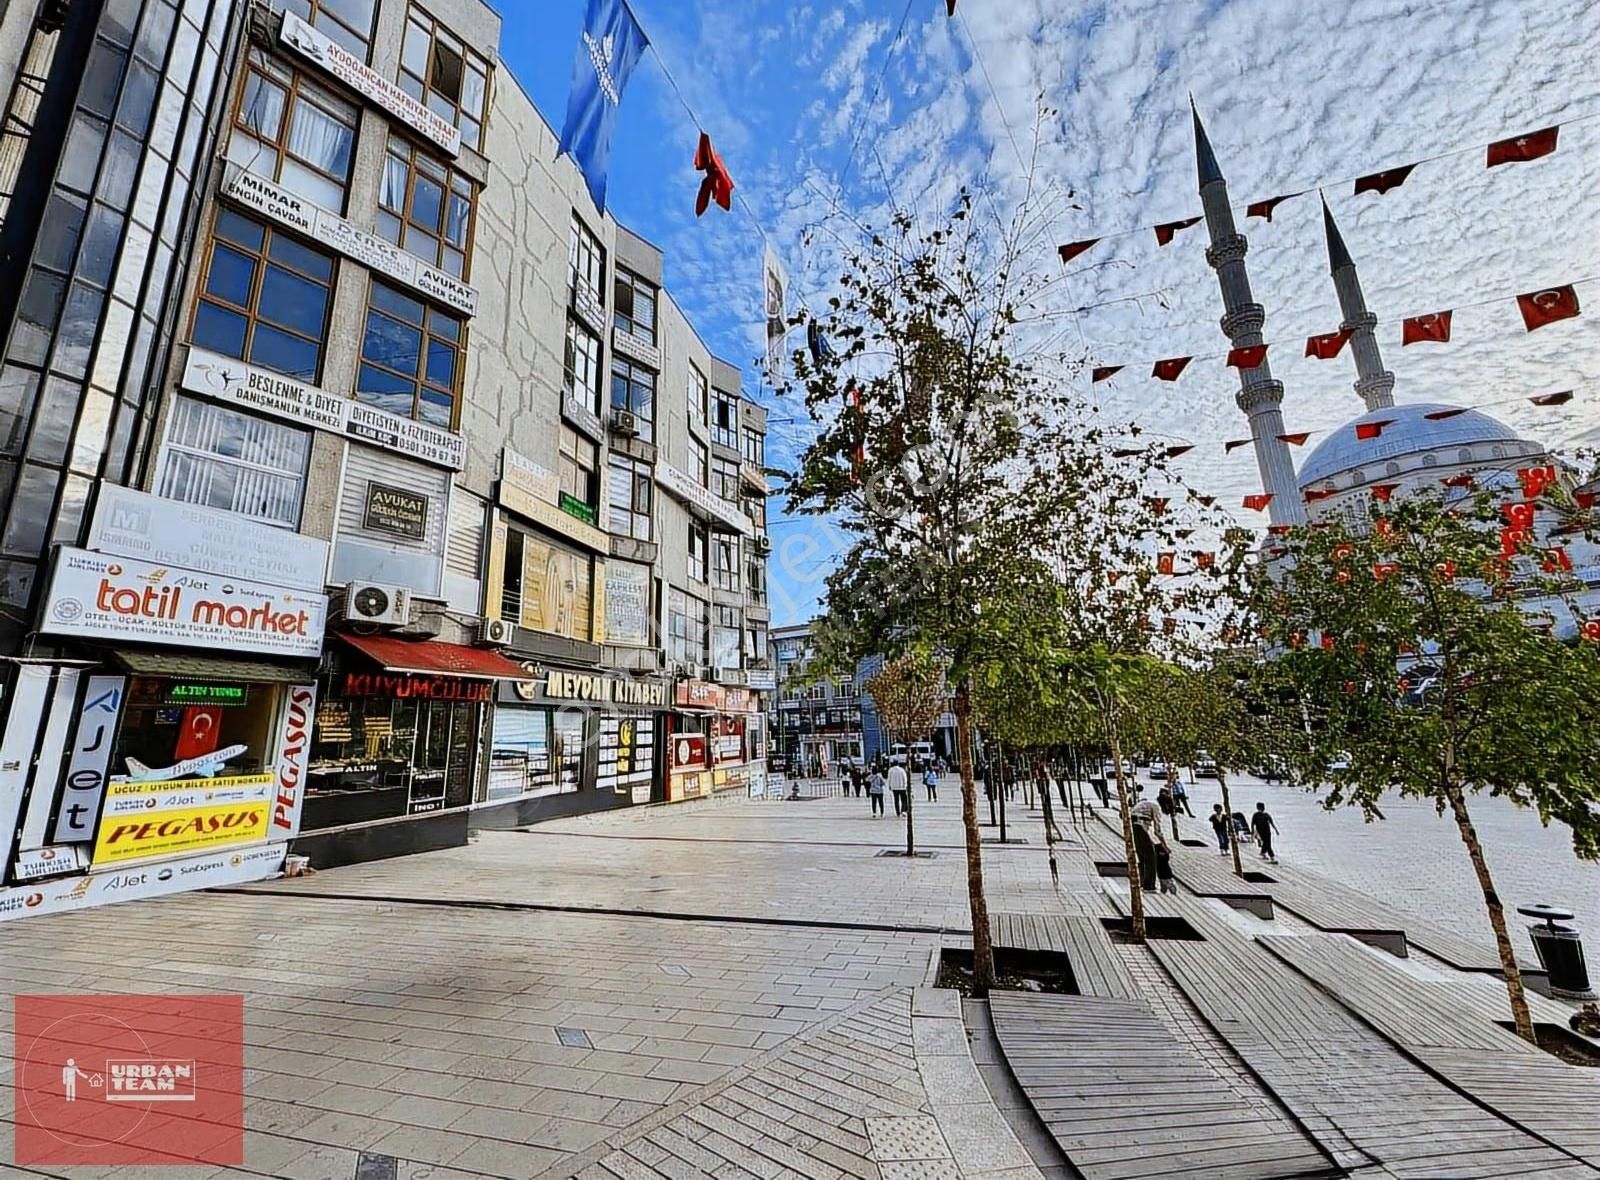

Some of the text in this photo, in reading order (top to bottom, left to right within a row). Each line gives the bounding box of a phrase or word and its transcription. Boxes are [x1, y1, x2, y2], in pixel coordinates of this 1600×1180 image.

[228, 182, 309, 229] ENGİN ÇAVDAR
[242, 175, 301, 212] MİMAR
[423, 269, 473, 299] AVUKAT
[236, 388, 341, 428] DANIŞMANLIK MERKEZİ
[248, 372, 343, 416] BESLENME & DİYET
[352, 406, 401, 434] DİYETİSYEN
[399, 438, 419, 453] 0501
[421, 444, 437, 458] 329
[438, 450, 448, 461] 67
[372, 491, 422, 512] AVUKAT
[67, 562, 106, 573] AIRLINES
[69, 556, 107, 568] TURKISH
[84, 612, 111, 621] OTEL
[118, 613, 145, 625] UÇAK
[96, 578, 181, 620] tatil
[192, 601, 309, 636] market
[546, 670, 611, 701] MEYDAN
[615, 675, 666, 705] KİTABEVİ
[273, 686, 314, 830] PEGASUS
[344, 764, 378, 773] ALTIN
[114, 785, 142, 794] UCUZ
[150, 782, 183, 791] UYGUN
[185, 780, 209, 788] BİLET
[237, 776, 270, 784] NOKTASI
[106, 810, 263, 844] PEGASUS
[23, 857, 71, 870] TURKISH
[24, 864, 72, 876] AIRLINES
